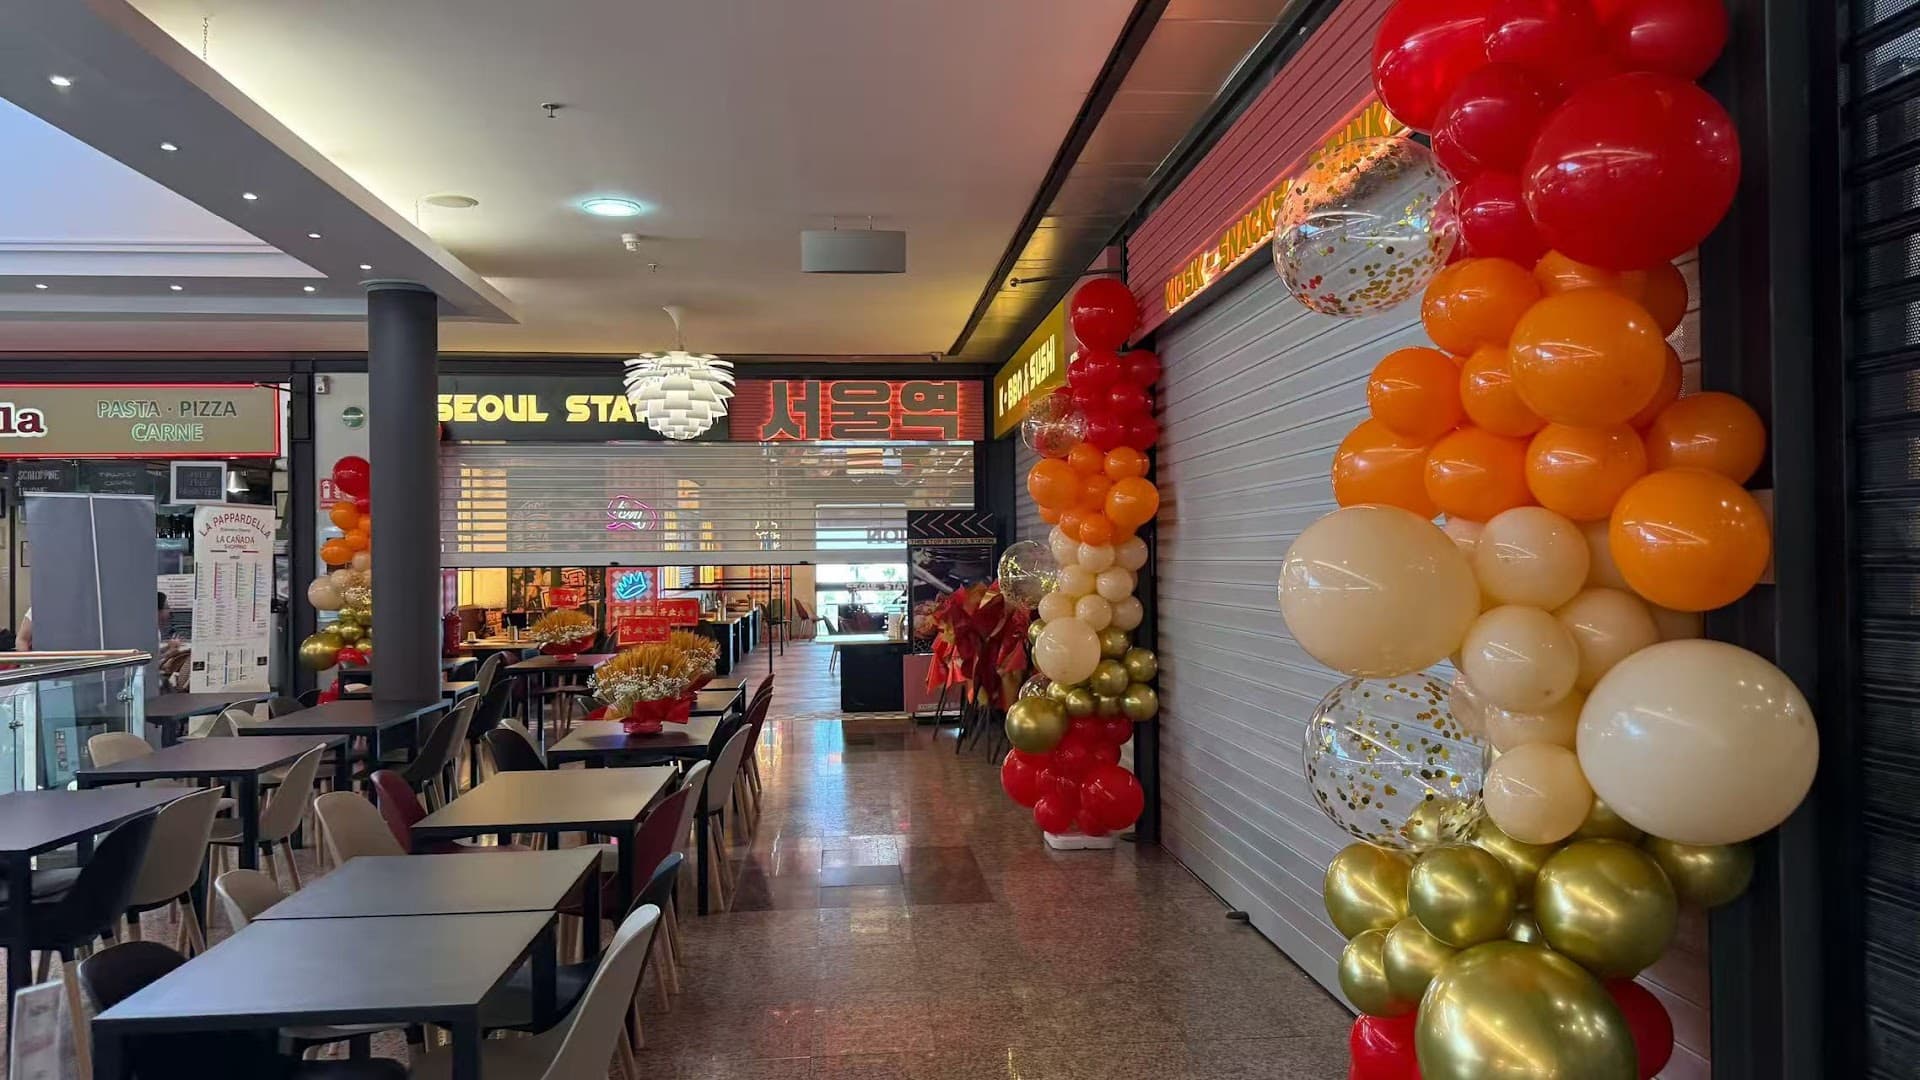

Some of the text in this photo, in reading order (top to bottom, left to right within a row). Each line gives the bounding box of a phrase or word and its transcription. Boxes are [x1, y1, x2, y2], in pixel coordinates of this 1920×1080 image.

[1165, 253, 1206, 311] KIOSK
[1029, 333, 1055, 391] SUSHI
[97, 400, 161, 418] PASTA
[179, 400, 238, 417] PIZZA
[437, 394, 549, 422] SEOUL
[761, 380, 961, 440] 서울역
[131, 422, 205, 442] CARNE
[199, 512, 272, 539] LA PAPPARDELLA
[216, 534, 255, 544] LA CAÑADA
